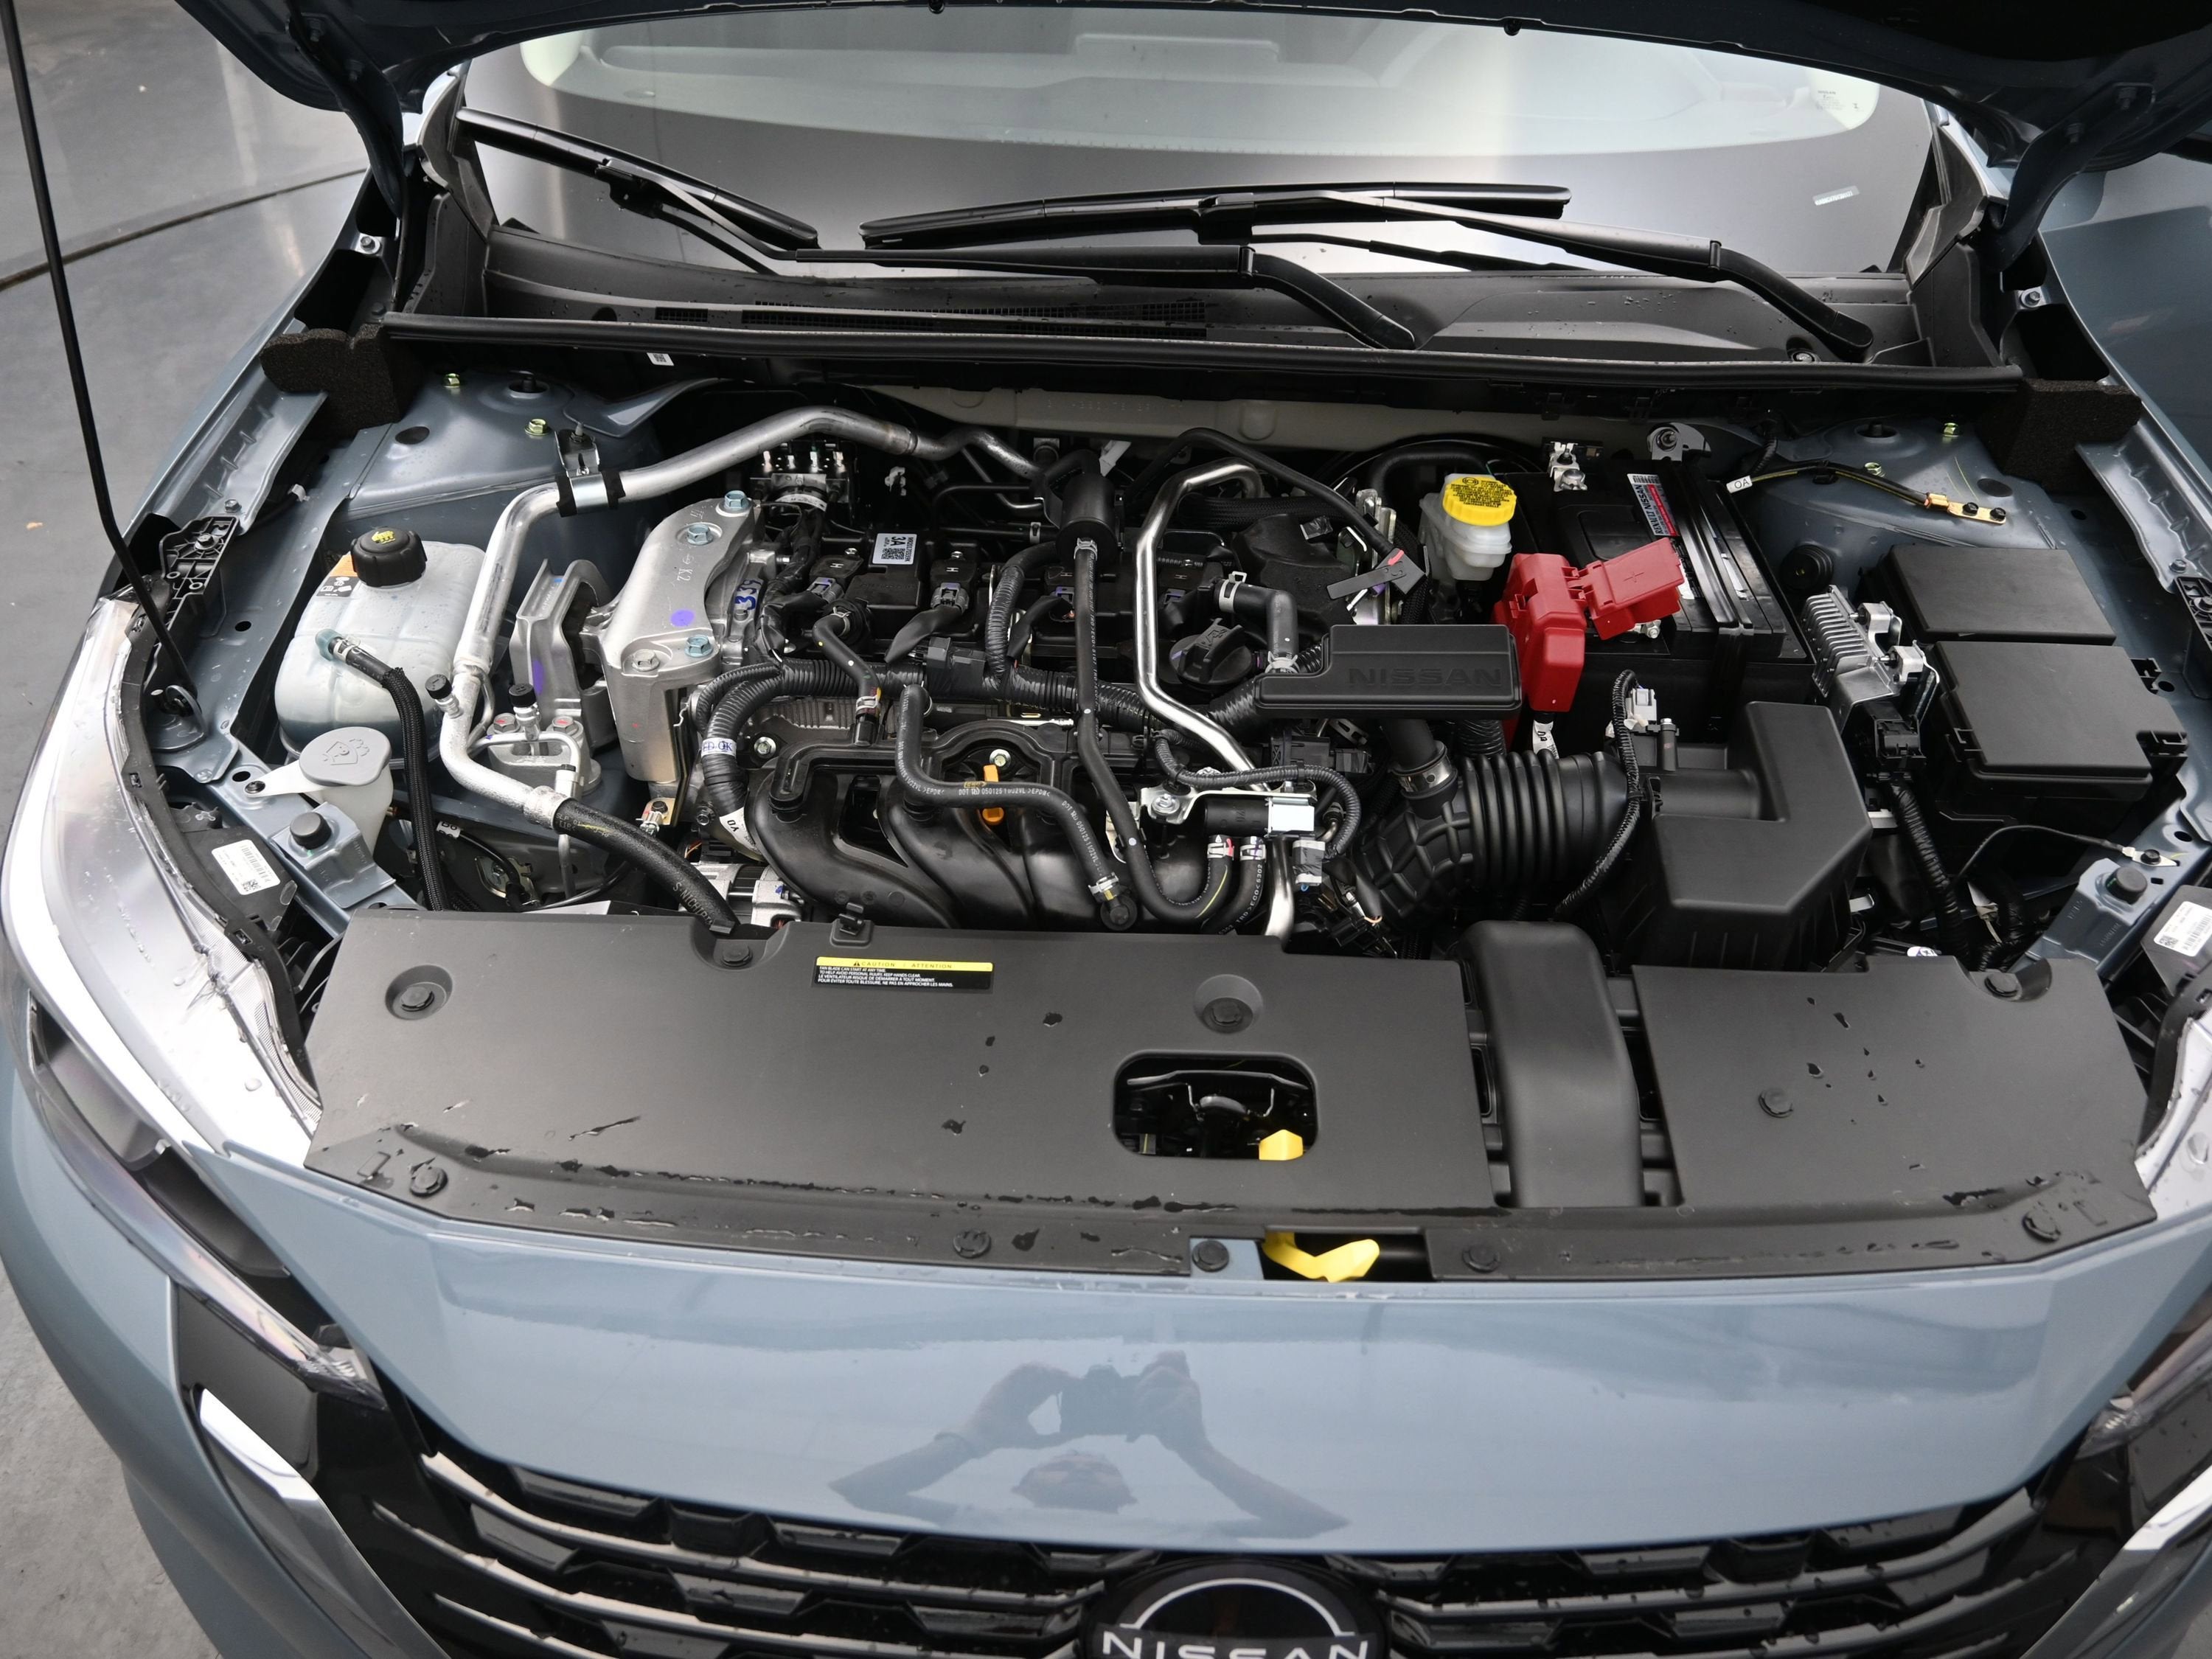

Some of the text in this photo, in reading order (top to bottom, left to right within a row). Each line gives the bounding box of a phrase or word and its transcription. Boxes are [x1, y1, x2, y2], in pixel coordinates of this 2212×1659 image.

[1634, 484, 1652, 510] NISSAN
[1646, 509, 1664, 535] RENAULT
[891, 536, 906, 546] 3A
[1349, 667, 1503, 686] NISSAN
